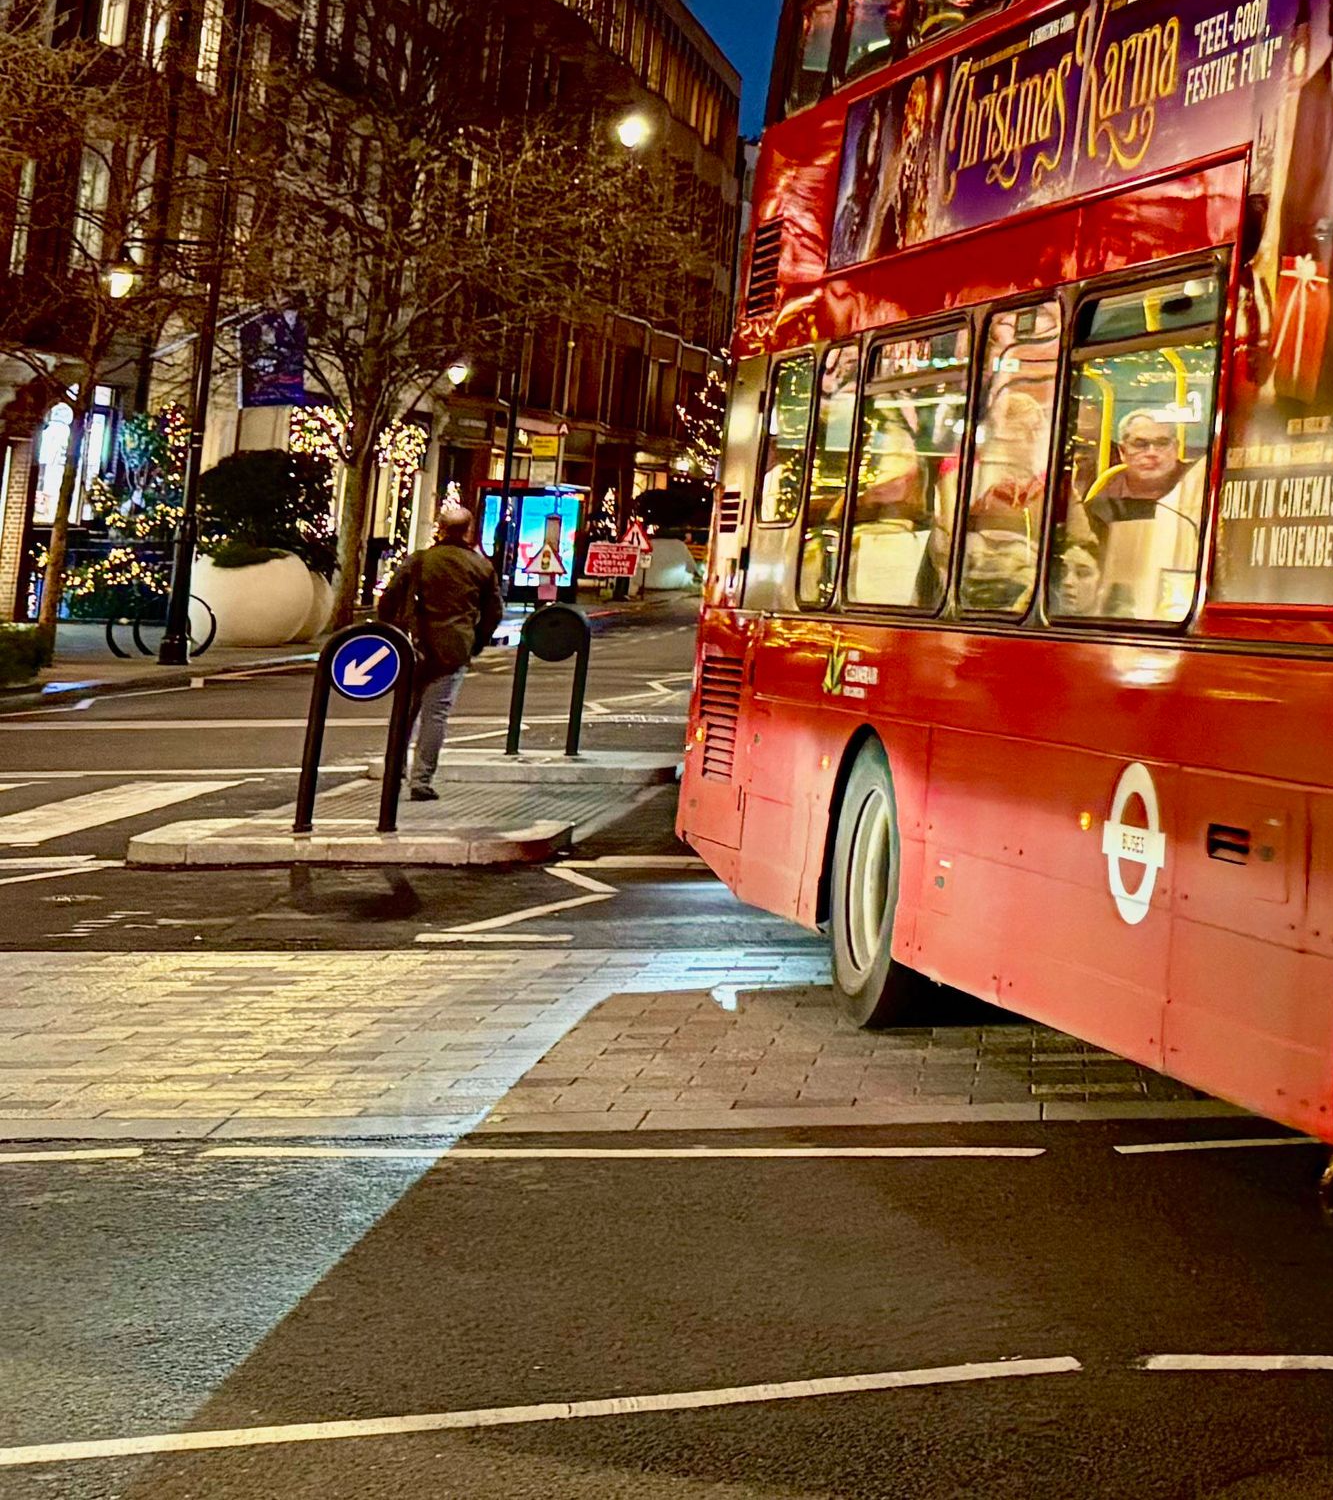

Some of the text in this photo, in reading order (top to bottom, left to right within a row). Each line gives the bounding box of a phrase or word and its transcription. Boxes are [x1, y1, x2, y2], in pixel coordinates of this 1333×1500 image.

[1184, 51, 1238, 107] FESTIVE
[943, 55, 1073, 193] Christmas
[1223, 480, 1257, 519] ONLY
[1259, 478, 1277, 518] IN
[1251, 526, 1266, 567] 14
